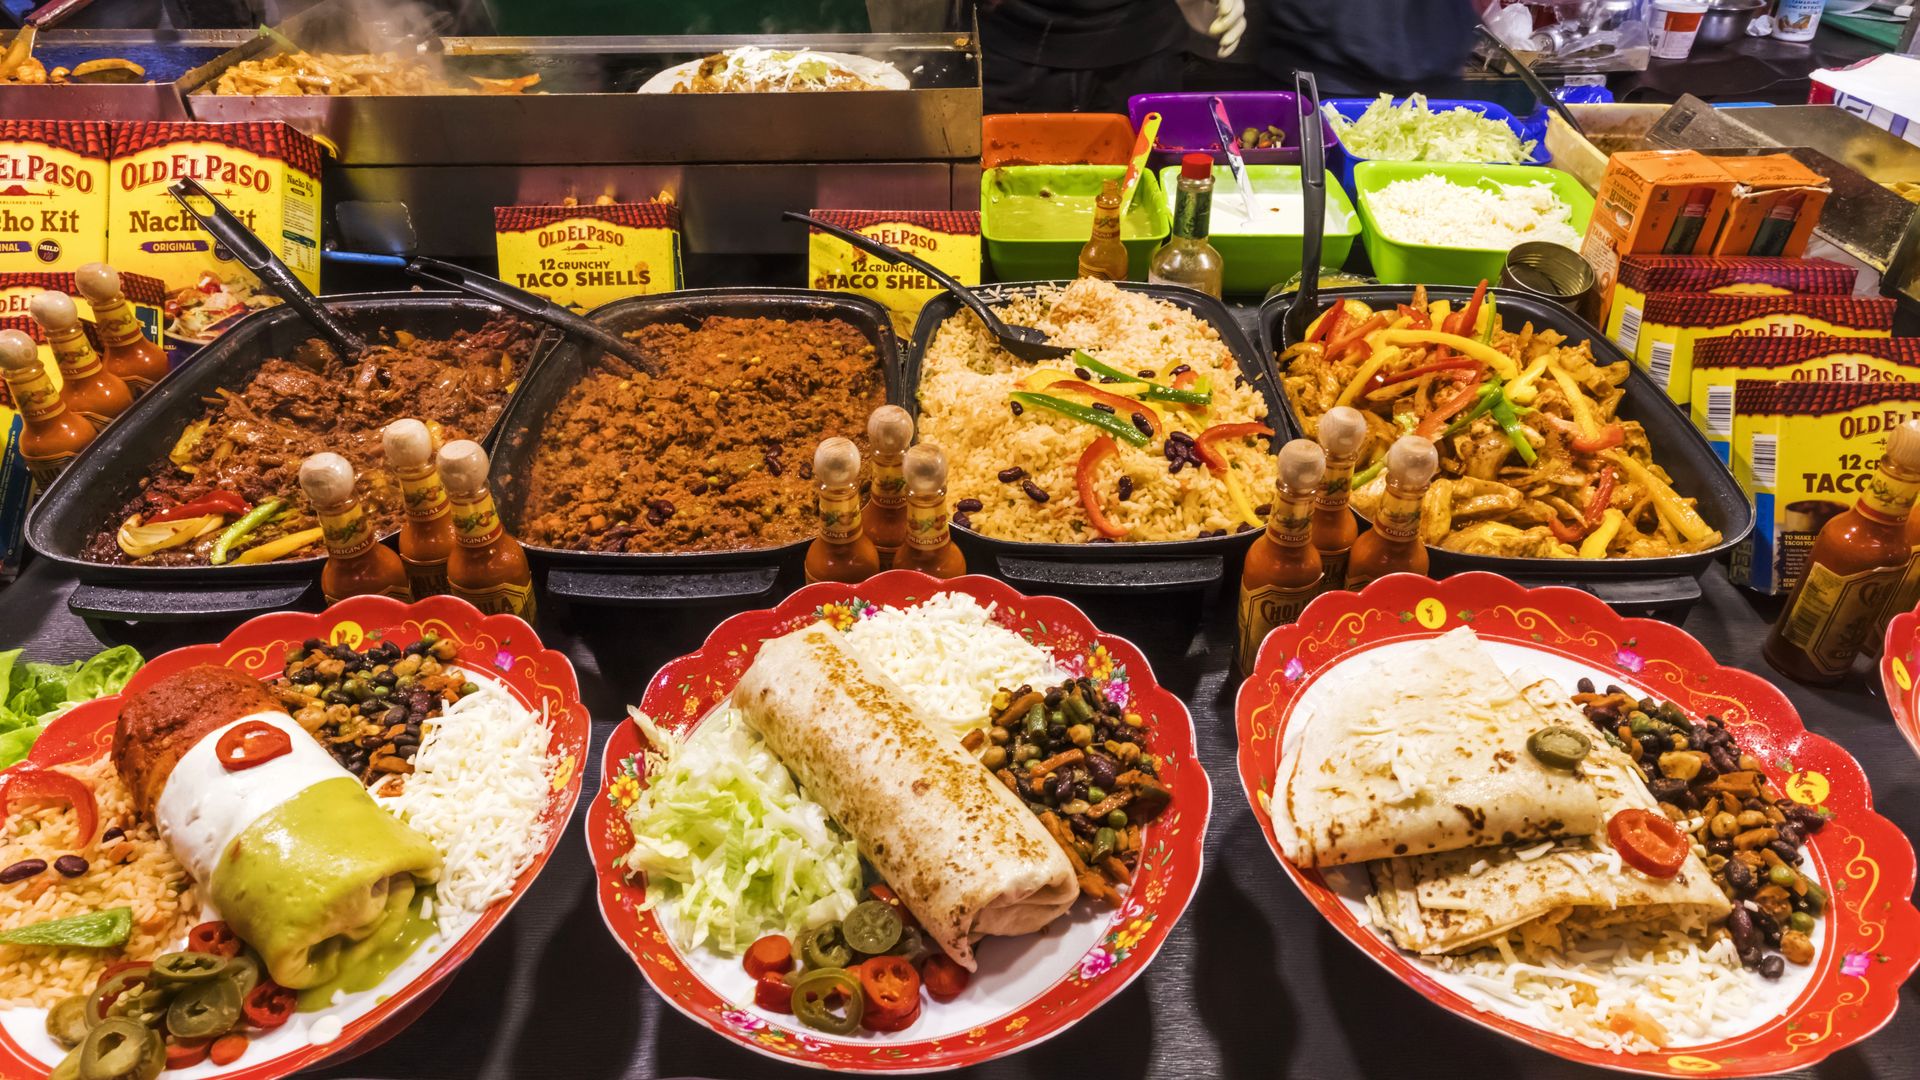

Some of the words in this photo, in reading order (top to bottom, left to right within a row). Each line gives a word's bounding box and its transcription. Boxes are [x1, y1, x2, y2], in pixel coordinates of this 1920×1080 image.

[121, 160, 168, 191] OLD
[171, 154, 202, 180] EL
[40, 209, 80, 234] Kit
[538, 231, 567, 248] OLD
[568, 226, 586, 241] EL
[881, 230, 899, 244] EL
[1593, 225, 1617, 250] TABASC
[0, 244, 20, 252] INAL
[39, 244, 60, 252] MILD
[152, 243, 197, 252] ORIGINAL
[539, 259, 556, 271] 12
[557, 261, 611, 270] CRUNCHY
[851, 261, 867, 272] 12
[516, 272, 569, 288] TACO
[575, 270, 652, 287] SHELLS
[827, 274, 879, 289] TACO
[886, 275, 961, 290] SHEL
[1791, 368, 1829, 382] OLD
[1831, 363, 1856, 382] EL
[1840, 416, 1881, 440] OLD
[1838, 454, 1862, 470] 12
[879, 495, 907, 505] ORIGIN
[1315, 496, 1346, 506] RIGINAL
[1279, 532, 1310, 543] ORIGIN
[1385, 527, 1416, 538] ORIGIN
[458, 534, 492, 545] RIGINAL
[911, 536, 943, 546] RIGINAL
